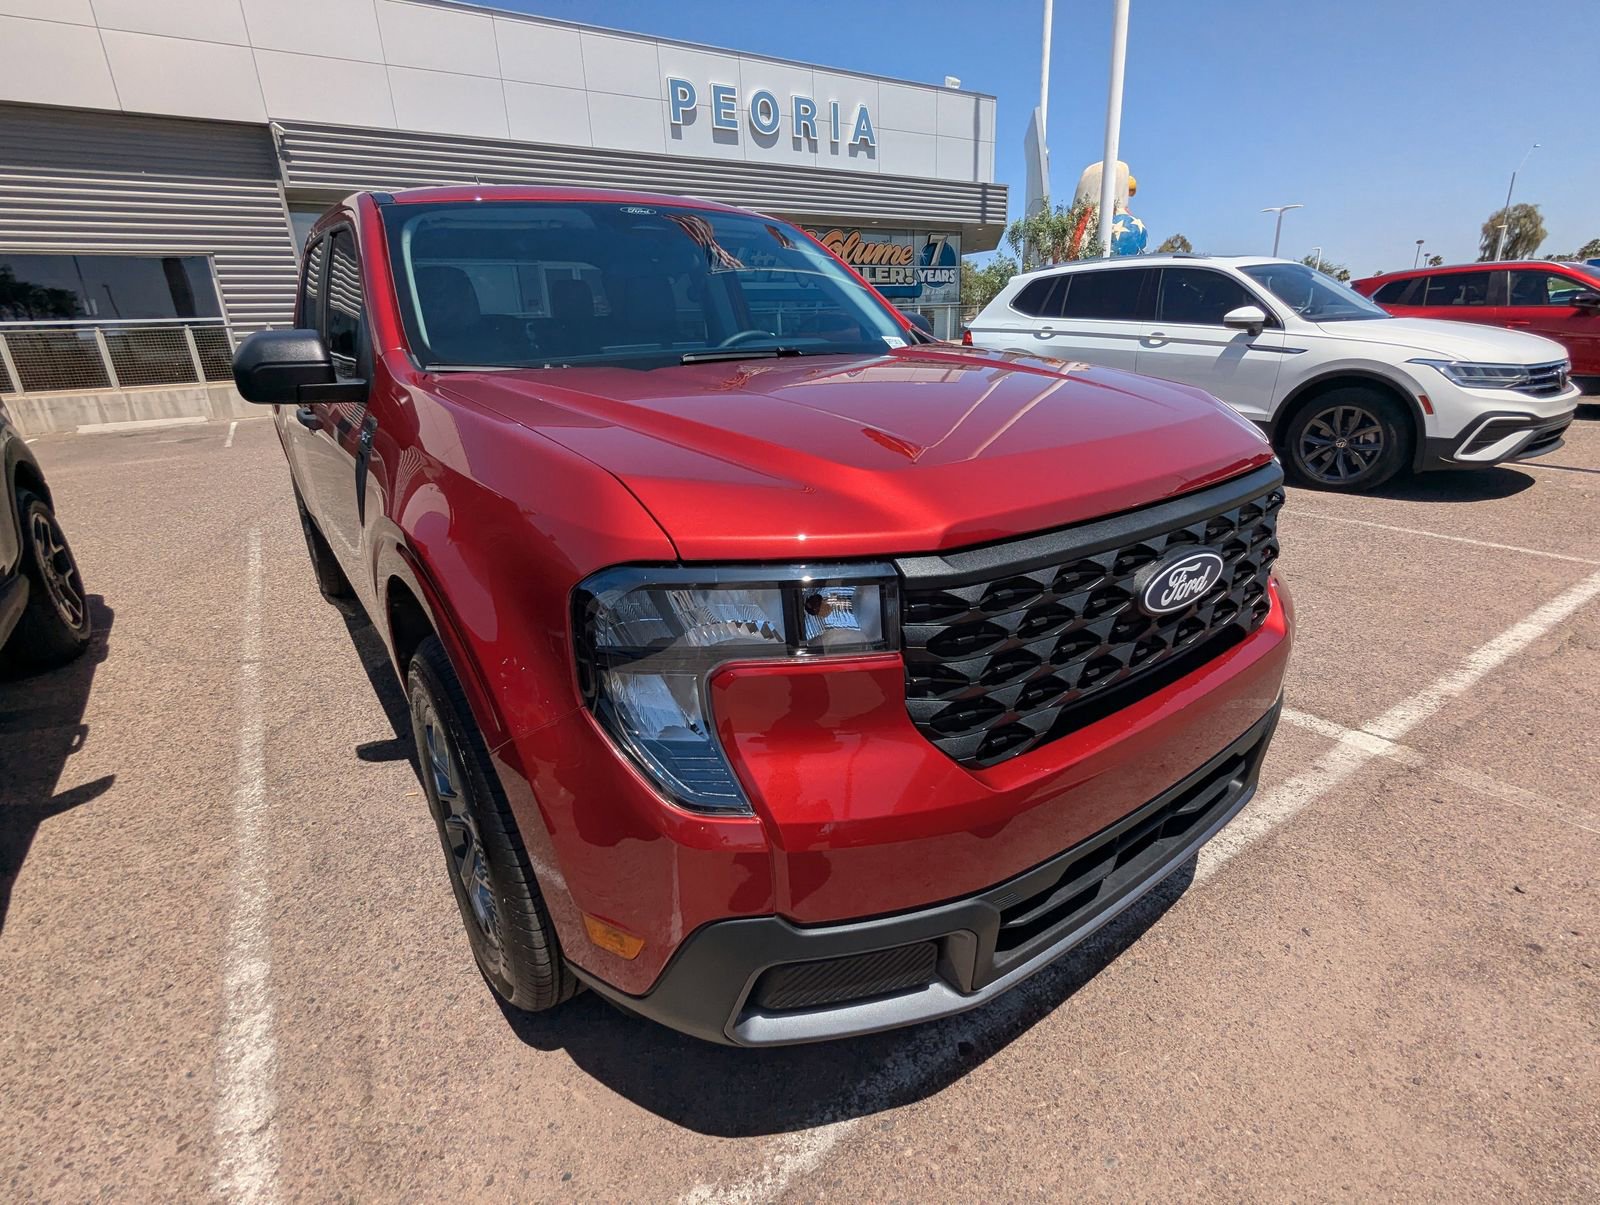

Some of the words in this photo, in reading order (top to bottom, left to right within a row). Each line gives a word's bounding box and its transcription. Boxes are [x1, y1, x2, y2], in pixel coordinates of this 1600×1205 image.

[667, 76, 876, 147] PEORIA
[928, 233, 948, 268] 7
[917, 269, 956, 283] YEARS
[1161, 562, 1212, 607] Ford
